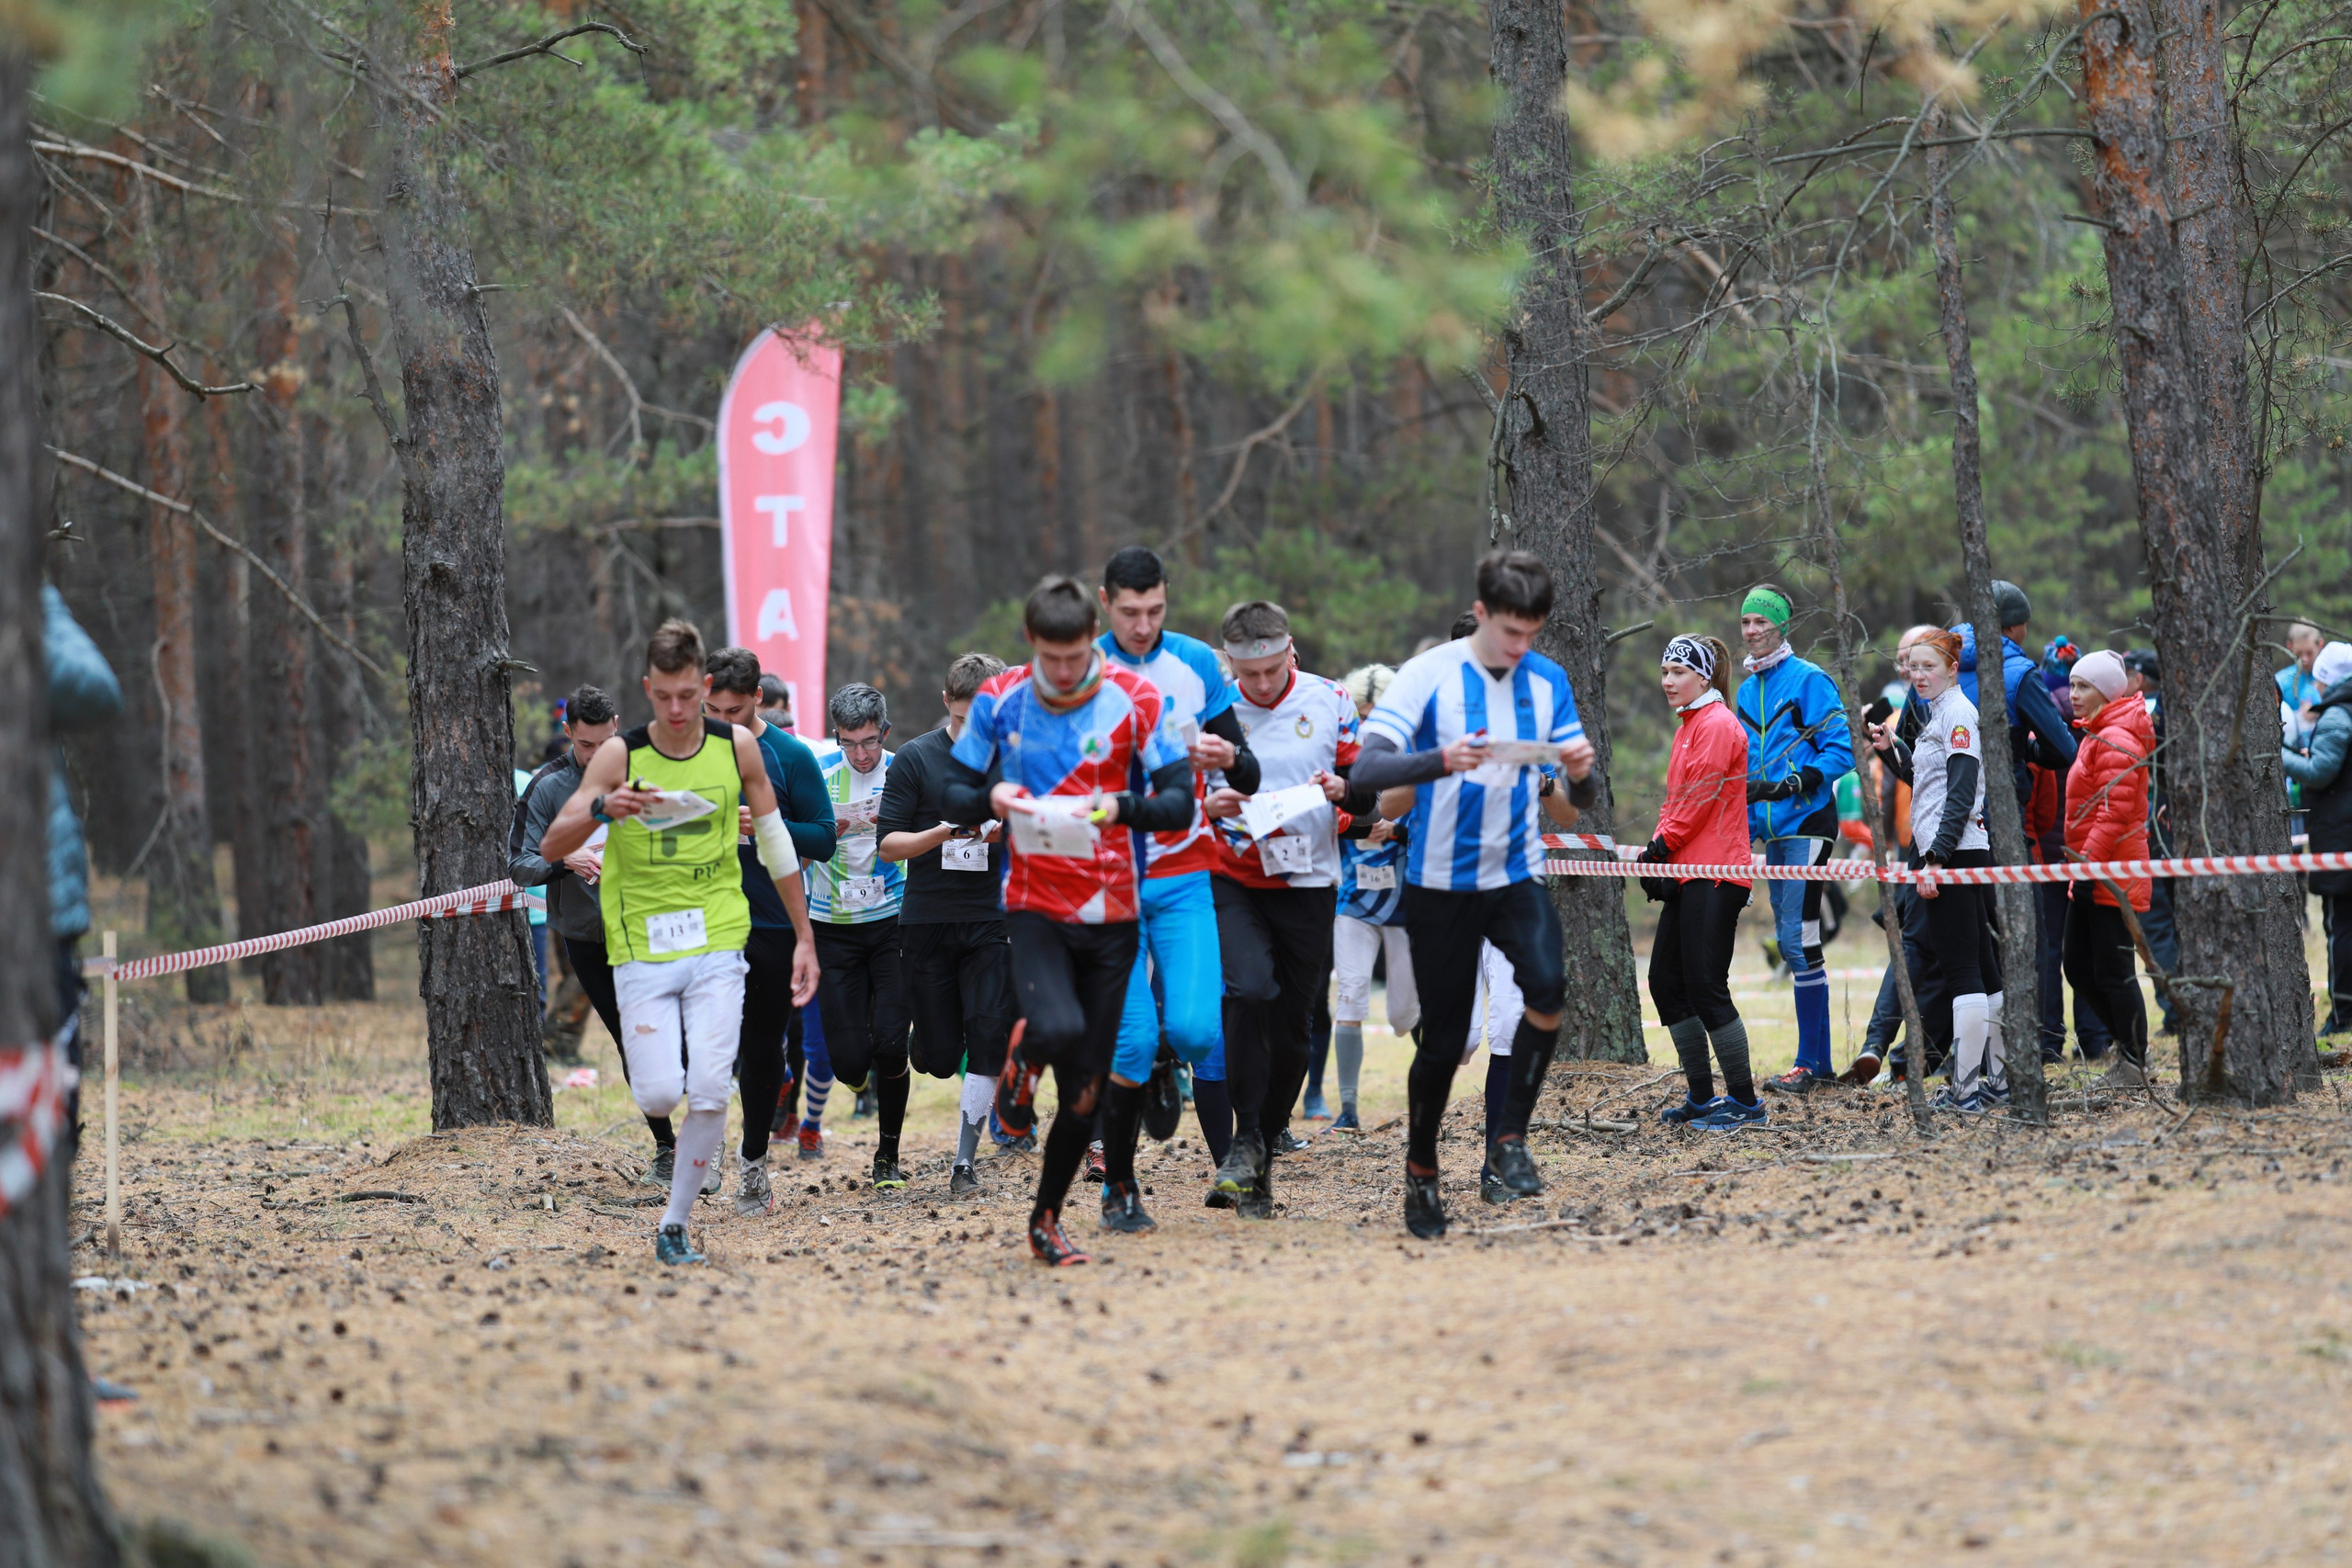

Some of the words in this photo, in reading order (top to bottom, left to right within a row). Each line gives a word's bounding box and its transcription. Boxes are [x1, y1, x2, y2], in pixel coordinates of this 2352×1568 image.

[963, 849, 970, 860] 6
[1282, 850, 1289, 861] 2
[860, 889, 866, 898] 9
[670, 924, 684, 938] 13
